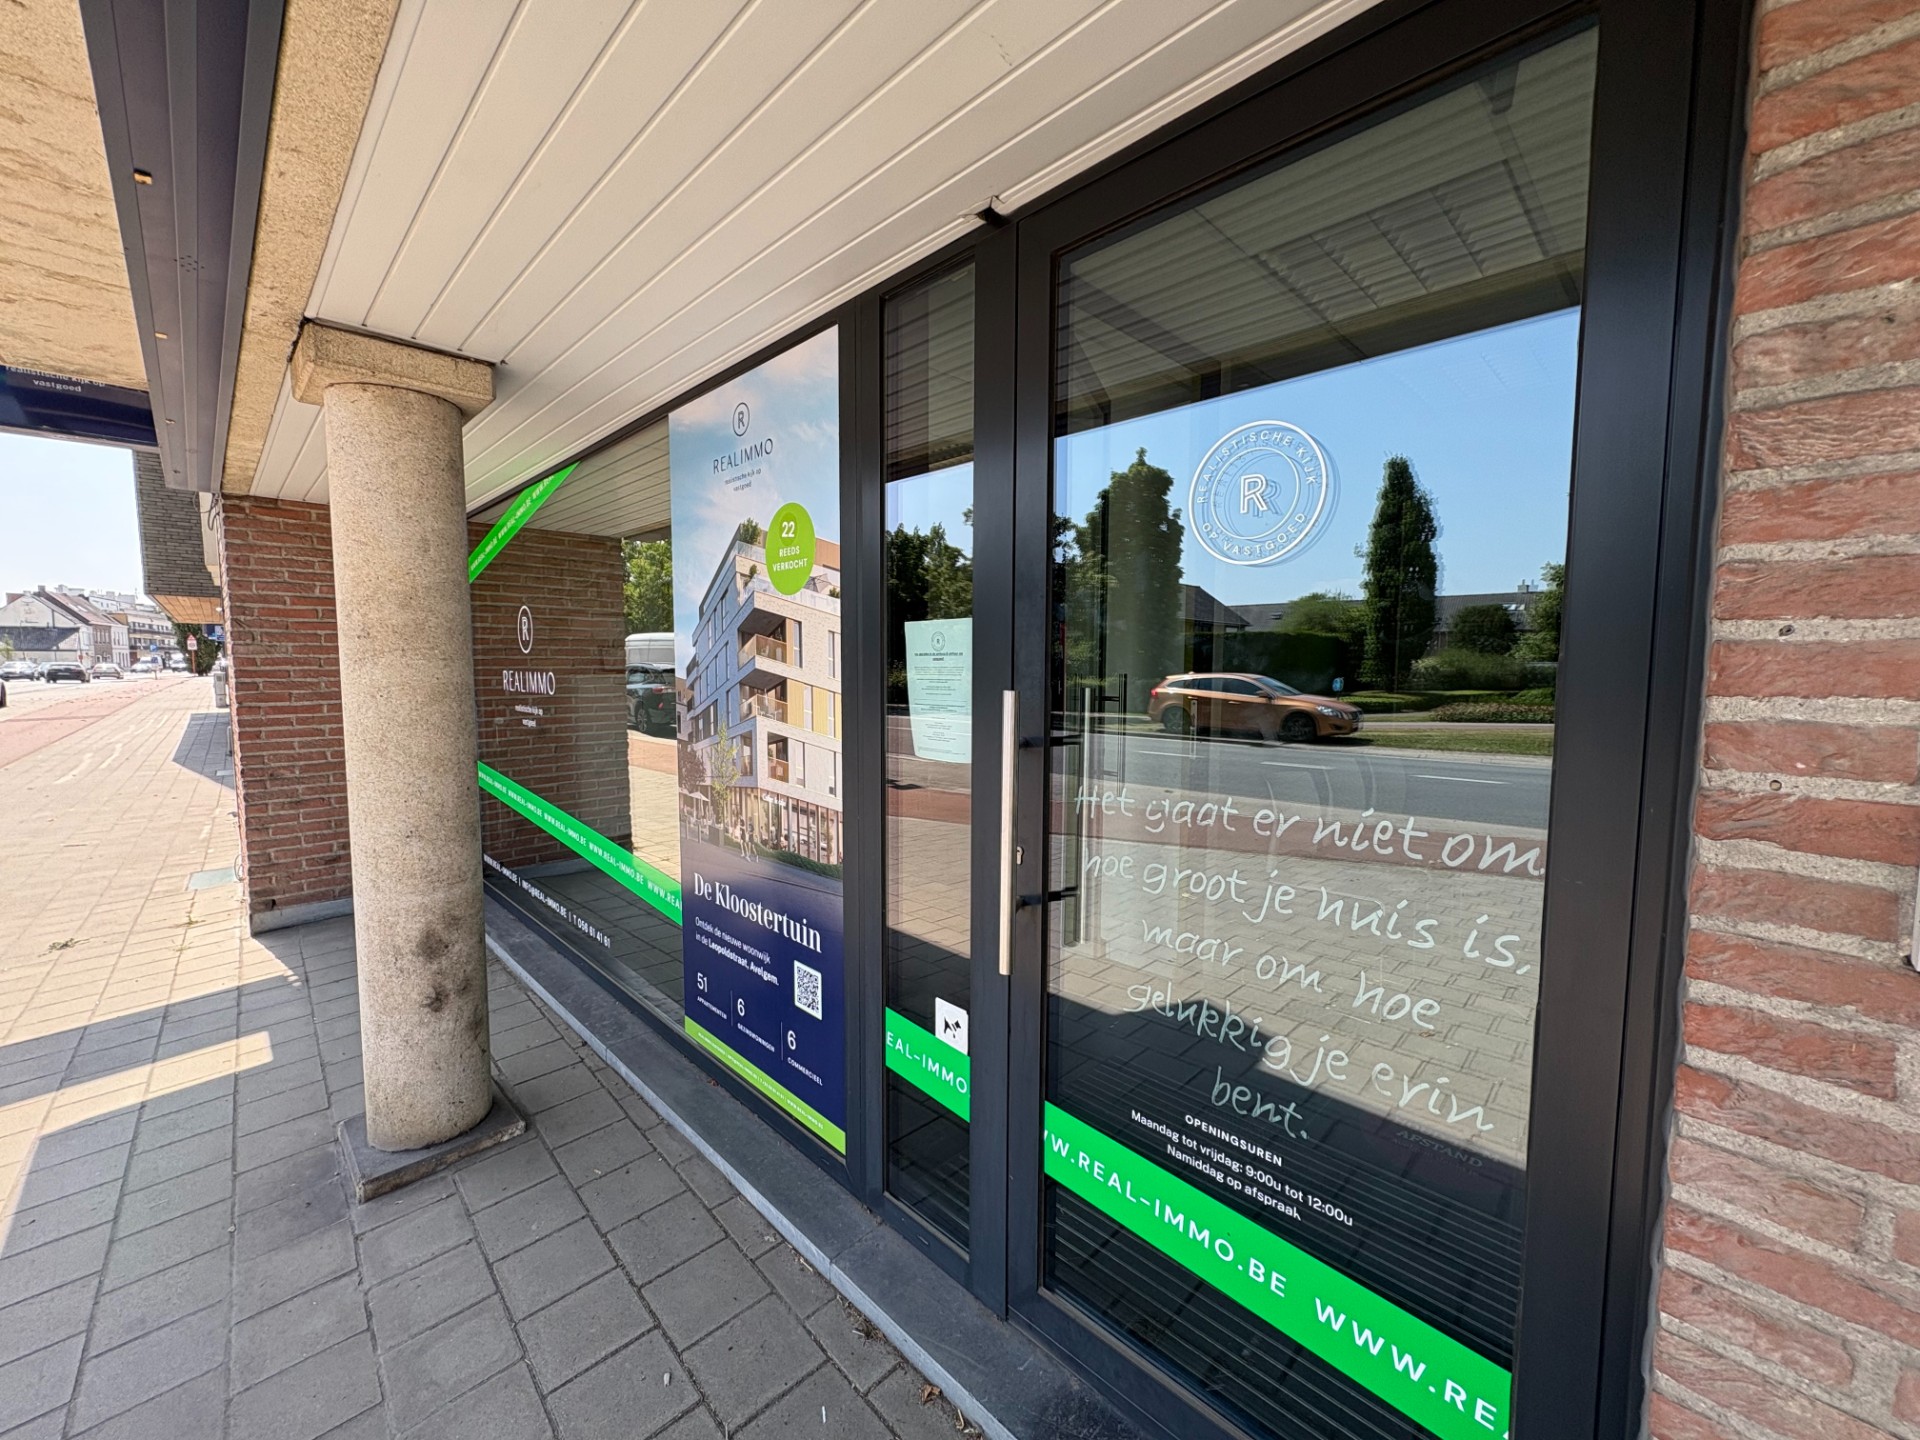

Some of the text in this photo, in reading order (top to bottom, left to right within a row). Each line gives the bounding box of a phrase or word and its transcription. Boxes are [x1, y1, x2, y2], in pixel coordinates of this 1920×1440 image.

[32, 379, 82, 392] vastgoed
[713, 438, 774, 475] REALIMMO
[1197, 430, 1318, 504] REALISTISCHE KIJK
[1239, 473, 1268, 514] R
[781, 521, 796, 538] 22
[1202, 512, 1306, 555] OP VASTGOED
[772, 557, 809, 572] VERKOCHT
[779, 545, 800, 558] REEDS
[502, 670, 556, 696] REALIMMO
[1074, 785, 1135, 818] Het
[1145, 796, 1239, 833] gaat
[1253, 808, 1300, 838] er
[1312, 808, 1429, 860] niet
[588, 841, 644, 885] WWW.REAL-IMMO.BE
[693, 872, 822, 954] De Kloostertuin
[713, 926, 722, 938] de
[1083, 847, 1531, 975] hoe groot je huis is,
[701, 933, 709, 946] de
[749, 961, 779, 986] Avelgem.
[1141, 919, 1441, 1030] maar om hoe
[697, 972, 708, 993] 51
[737, 998, 746, 1017] 6
[787, 1030, 797, 1050] 6
[1122, 981, 1293, 1071] gelukkig
[1288, 1034, 1350, 1088] je
[787, 1057, 824, 1087] COMMERCIEEL
[1211, 1065, 1310, 1140] bent.
[1184, 1114, 1284, 1168] OPENINGSUREN
[1131, 1109, 1354, 1227] Maandag tot vrijdag: 9:00u tot 12:00u
[1166, 1143, 1302, 1222] Namiddag op afspraak
[1044, 1128, 1509, 1440] W.REAL-IMMO.BE WWW.RE
